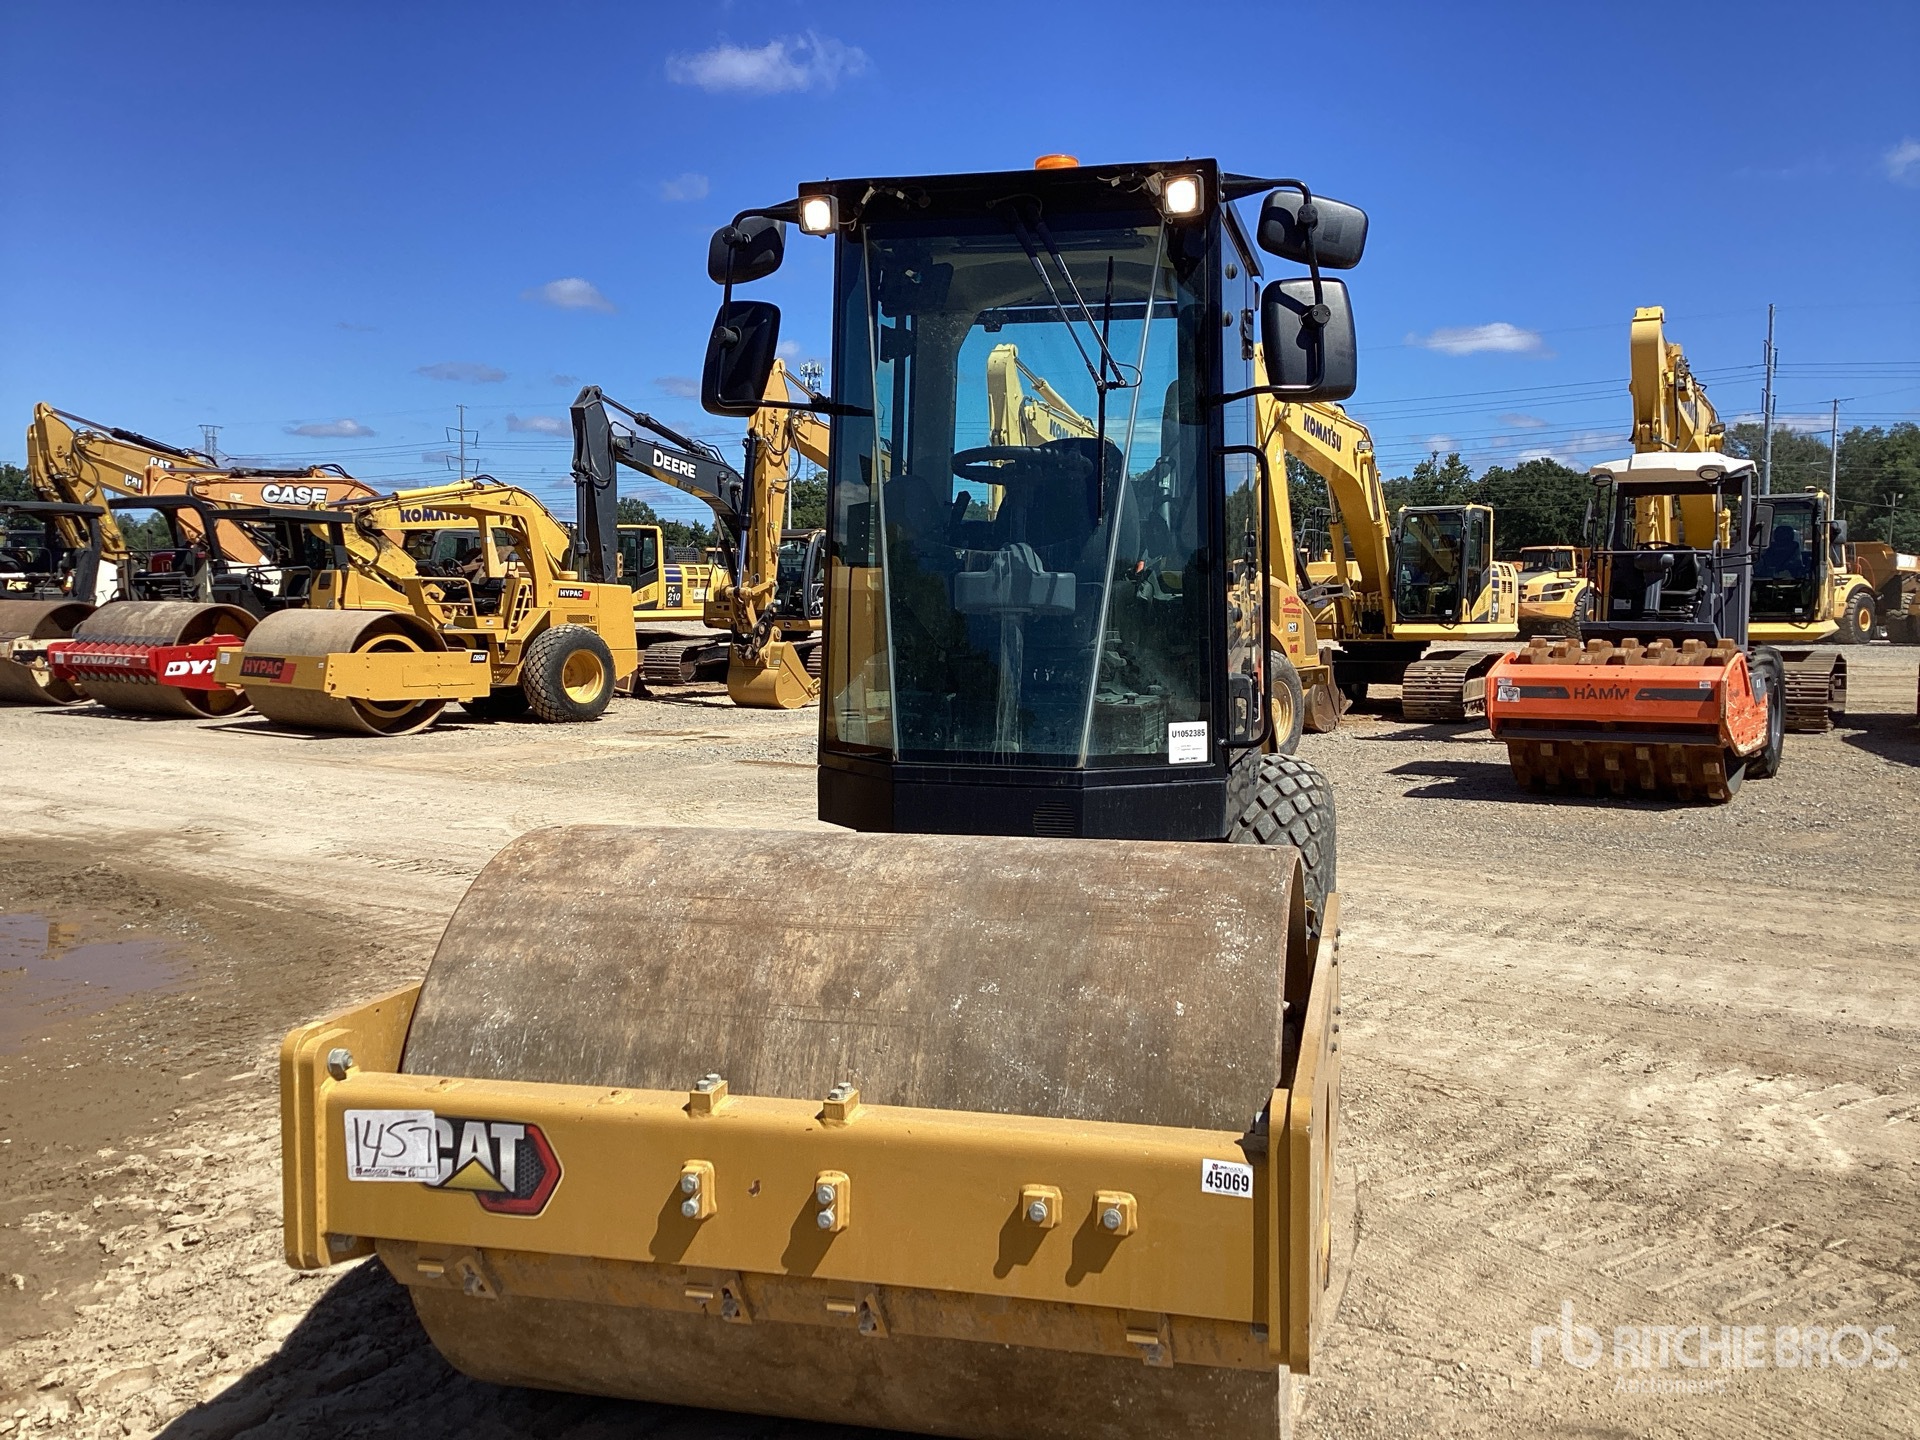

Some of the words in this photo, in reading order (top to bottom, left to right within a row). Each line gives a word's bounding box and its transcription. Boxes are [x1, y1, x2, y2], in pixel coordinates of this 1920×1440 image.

[1304, 412, 1342, 453] KOMATSU
[653, 448, 697, 479] DEERE
[261, 484, 328, 504] CASE
[559, 589, 583, 597] HYPAC
[667, 592, 681, 601] 210
[71, 655, 131, 666] DYNAPAC
[243, 659, 283, 675] HYPAC
[1573, 687, 1630, 700] HAMM
[1171, 729, 1206, 738] U1052385
[354, 1118, 432, 1168] 1457
[427, 1118, 525, 1193] CAT
[1205, 1170, 1250, 1192] 45069
